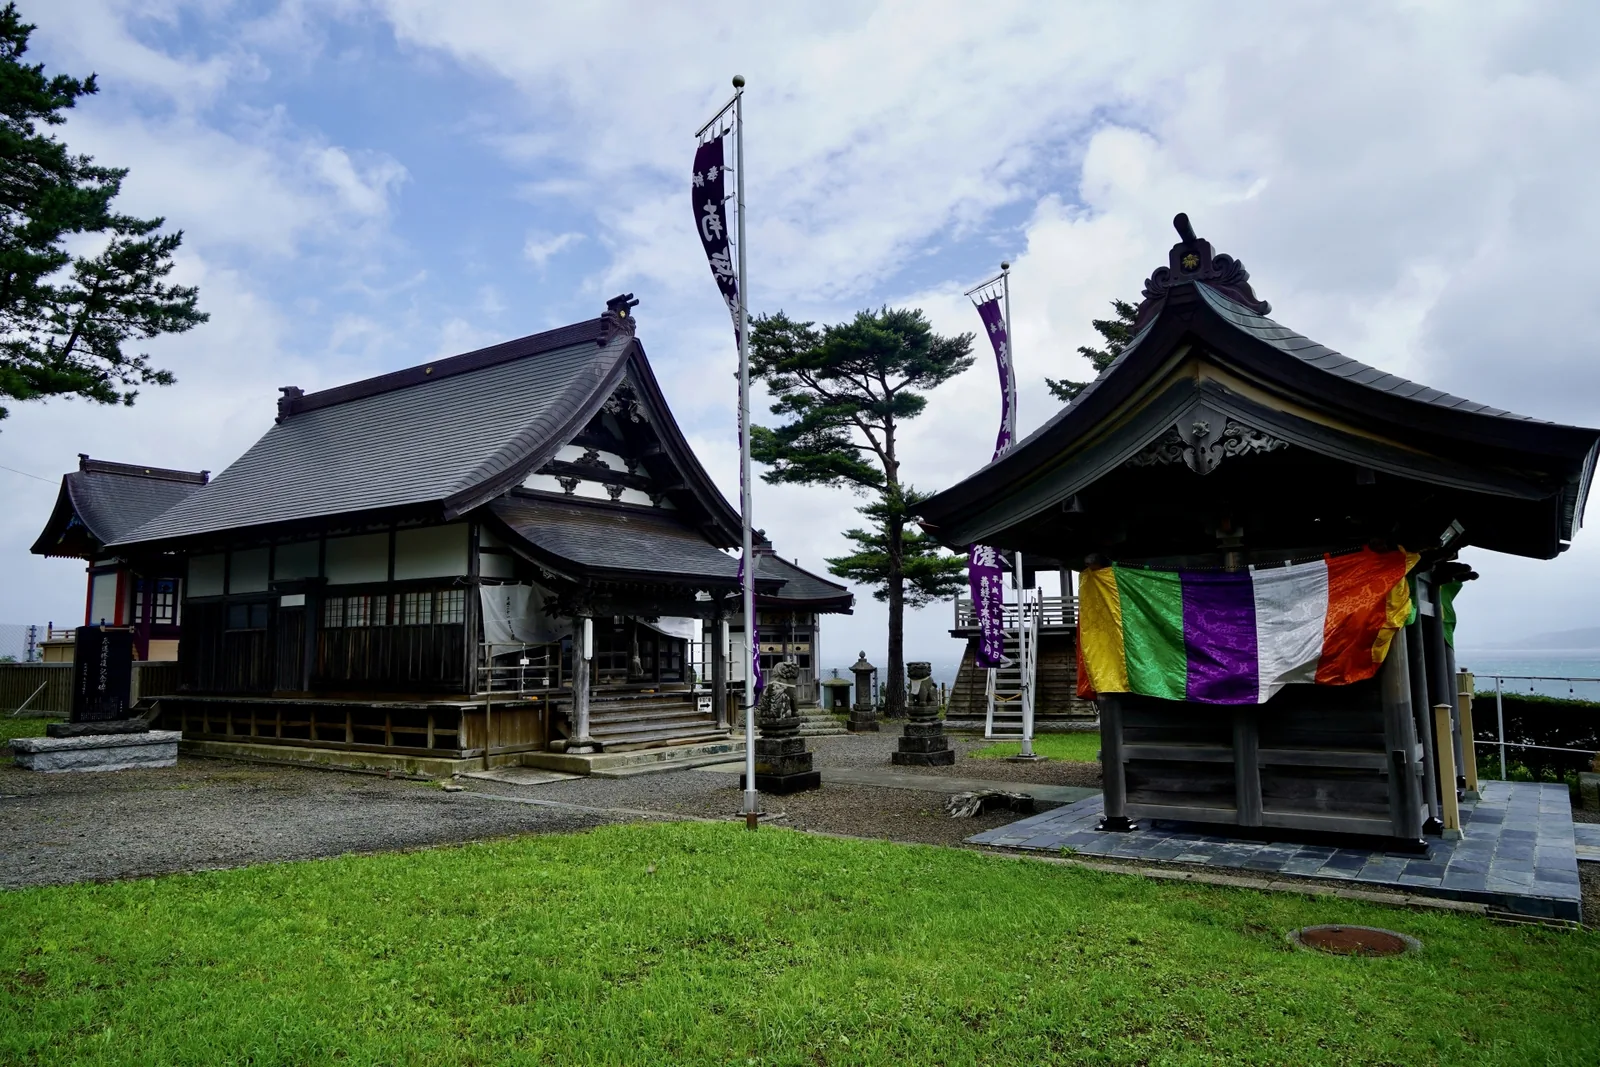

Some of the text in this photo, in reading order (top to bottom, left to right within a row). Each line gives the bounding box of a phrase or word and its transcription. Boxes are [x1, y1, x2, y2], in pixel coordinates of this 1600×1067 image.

[991, 575, 1000, 659] 平成二十四年吉日
